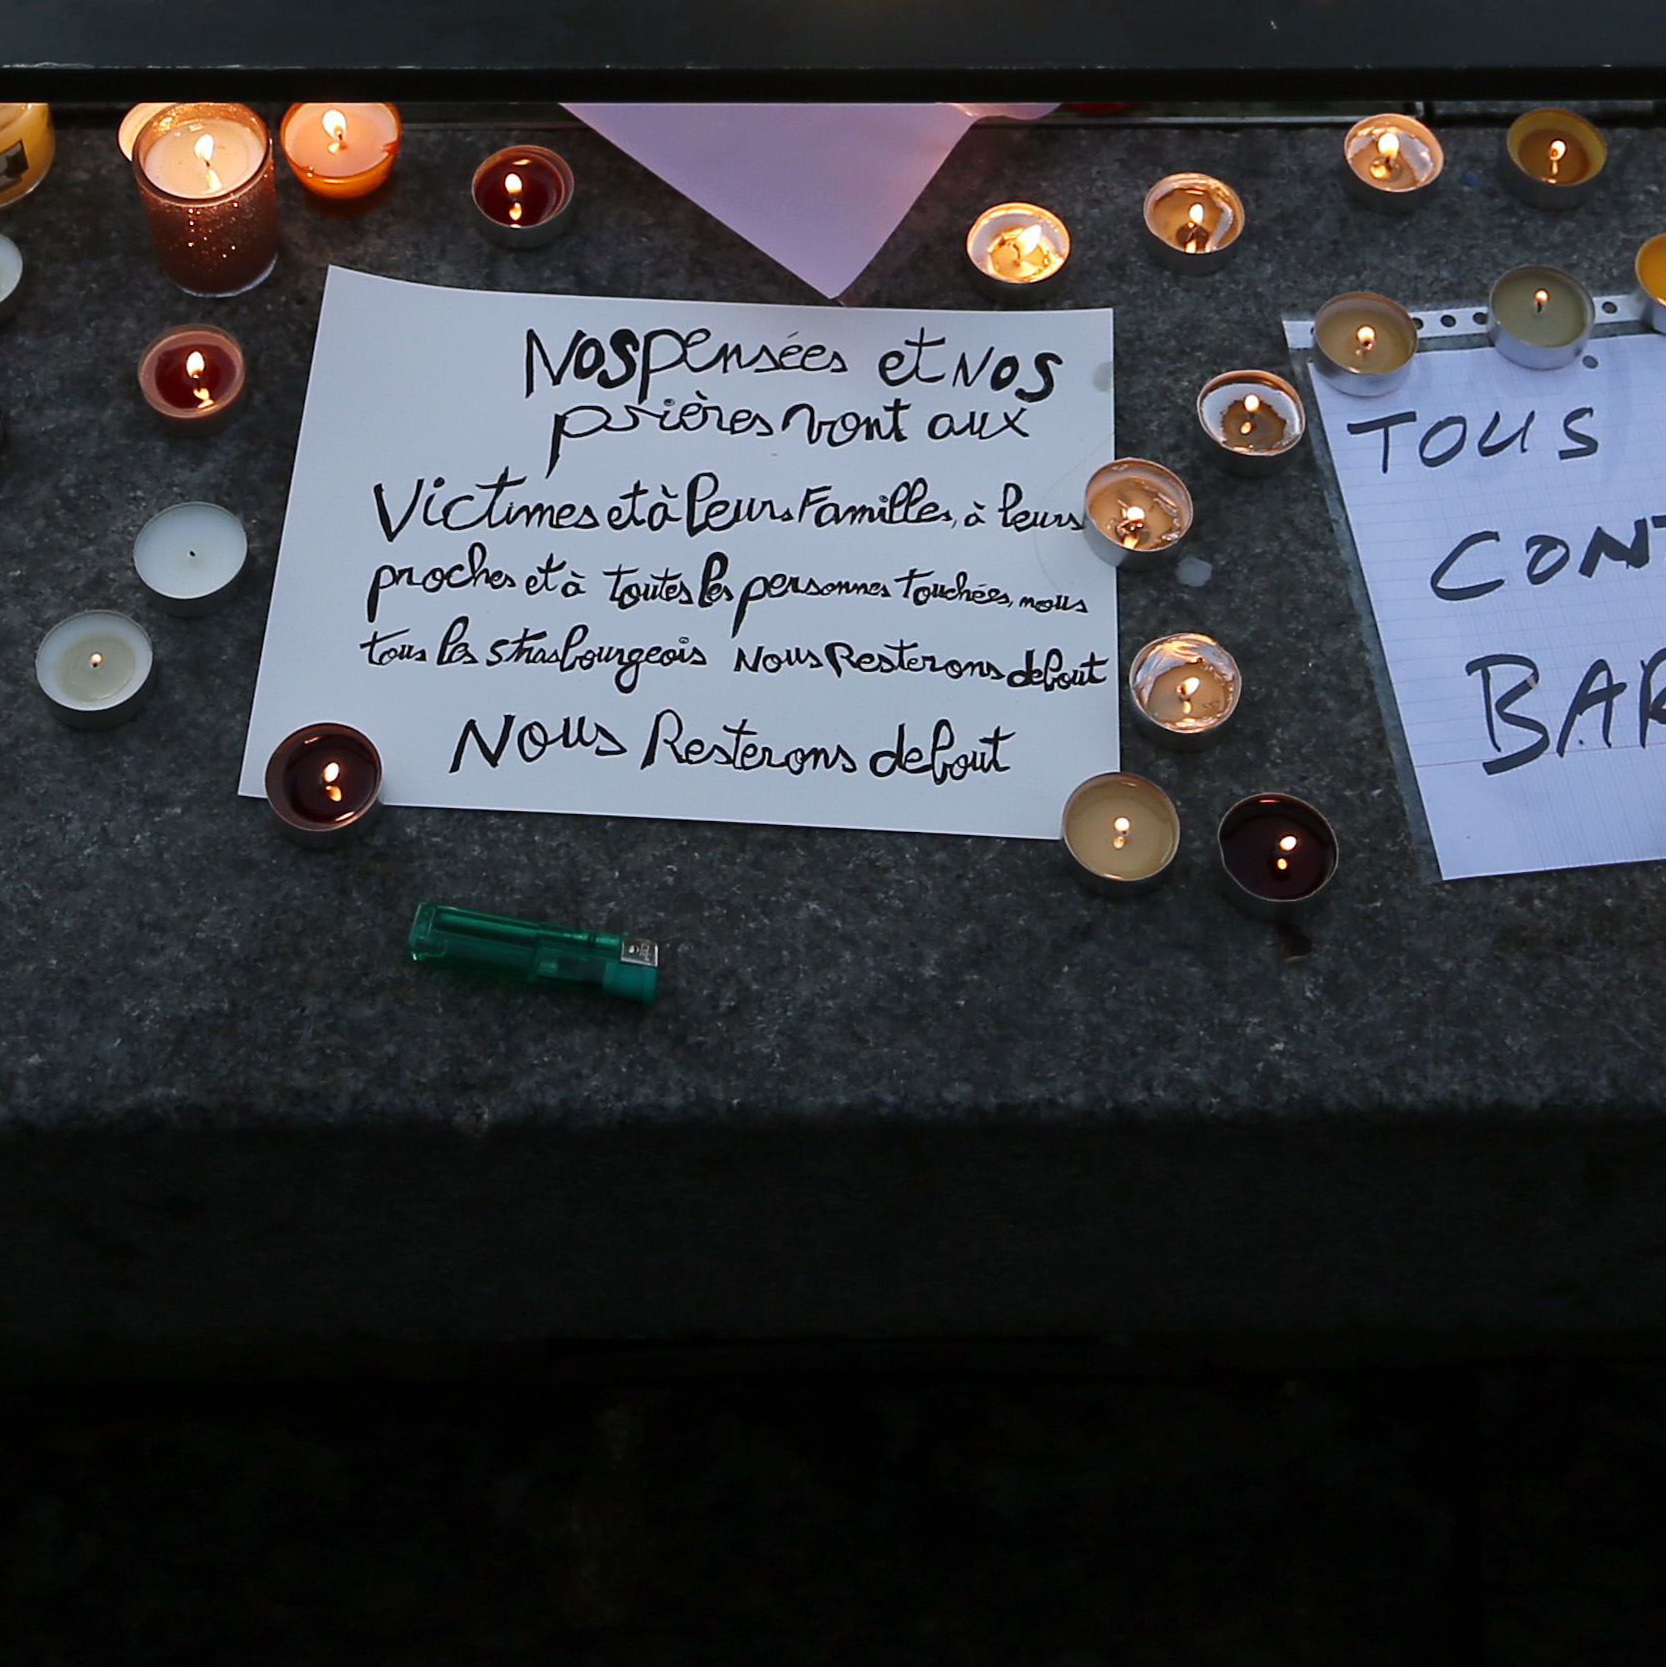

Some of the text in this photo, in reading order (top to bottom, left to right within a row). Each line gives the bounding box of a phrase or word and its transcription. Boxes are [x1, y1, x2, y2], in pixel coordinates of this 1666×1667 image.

[879, 326, 947, 387] et
[546, 390, 1031, 480] prières vont aux
[1346, 406, 1600, 475] TOUS
[373, 466, 601, 543] Victimes
[606, 479, 649, 531] et
[647, 483, 683, 532] à
[686, 471, 794, 538] leurs
[963, 500, 987, 528] à
[998, 482, 1086, 533] leurs
[367, 541, 517, 623] proches
[525, 552, 567, 596] et
[561, 570, 587, 598] à
[698, 551, 735, 609] les
[731, 572, 892, 639] personnes
[1018, 592, 1089, 614] nous
[358, 628, 428, 666] tous
[436, 615, 479, 666] les
[733, 644, 824, 674] Nous
[823, 638, 1008, 679] Resterons
[1006, 647, 1110, 693] debout
[448, 708, 1018, 786] Nous Resterons debout
